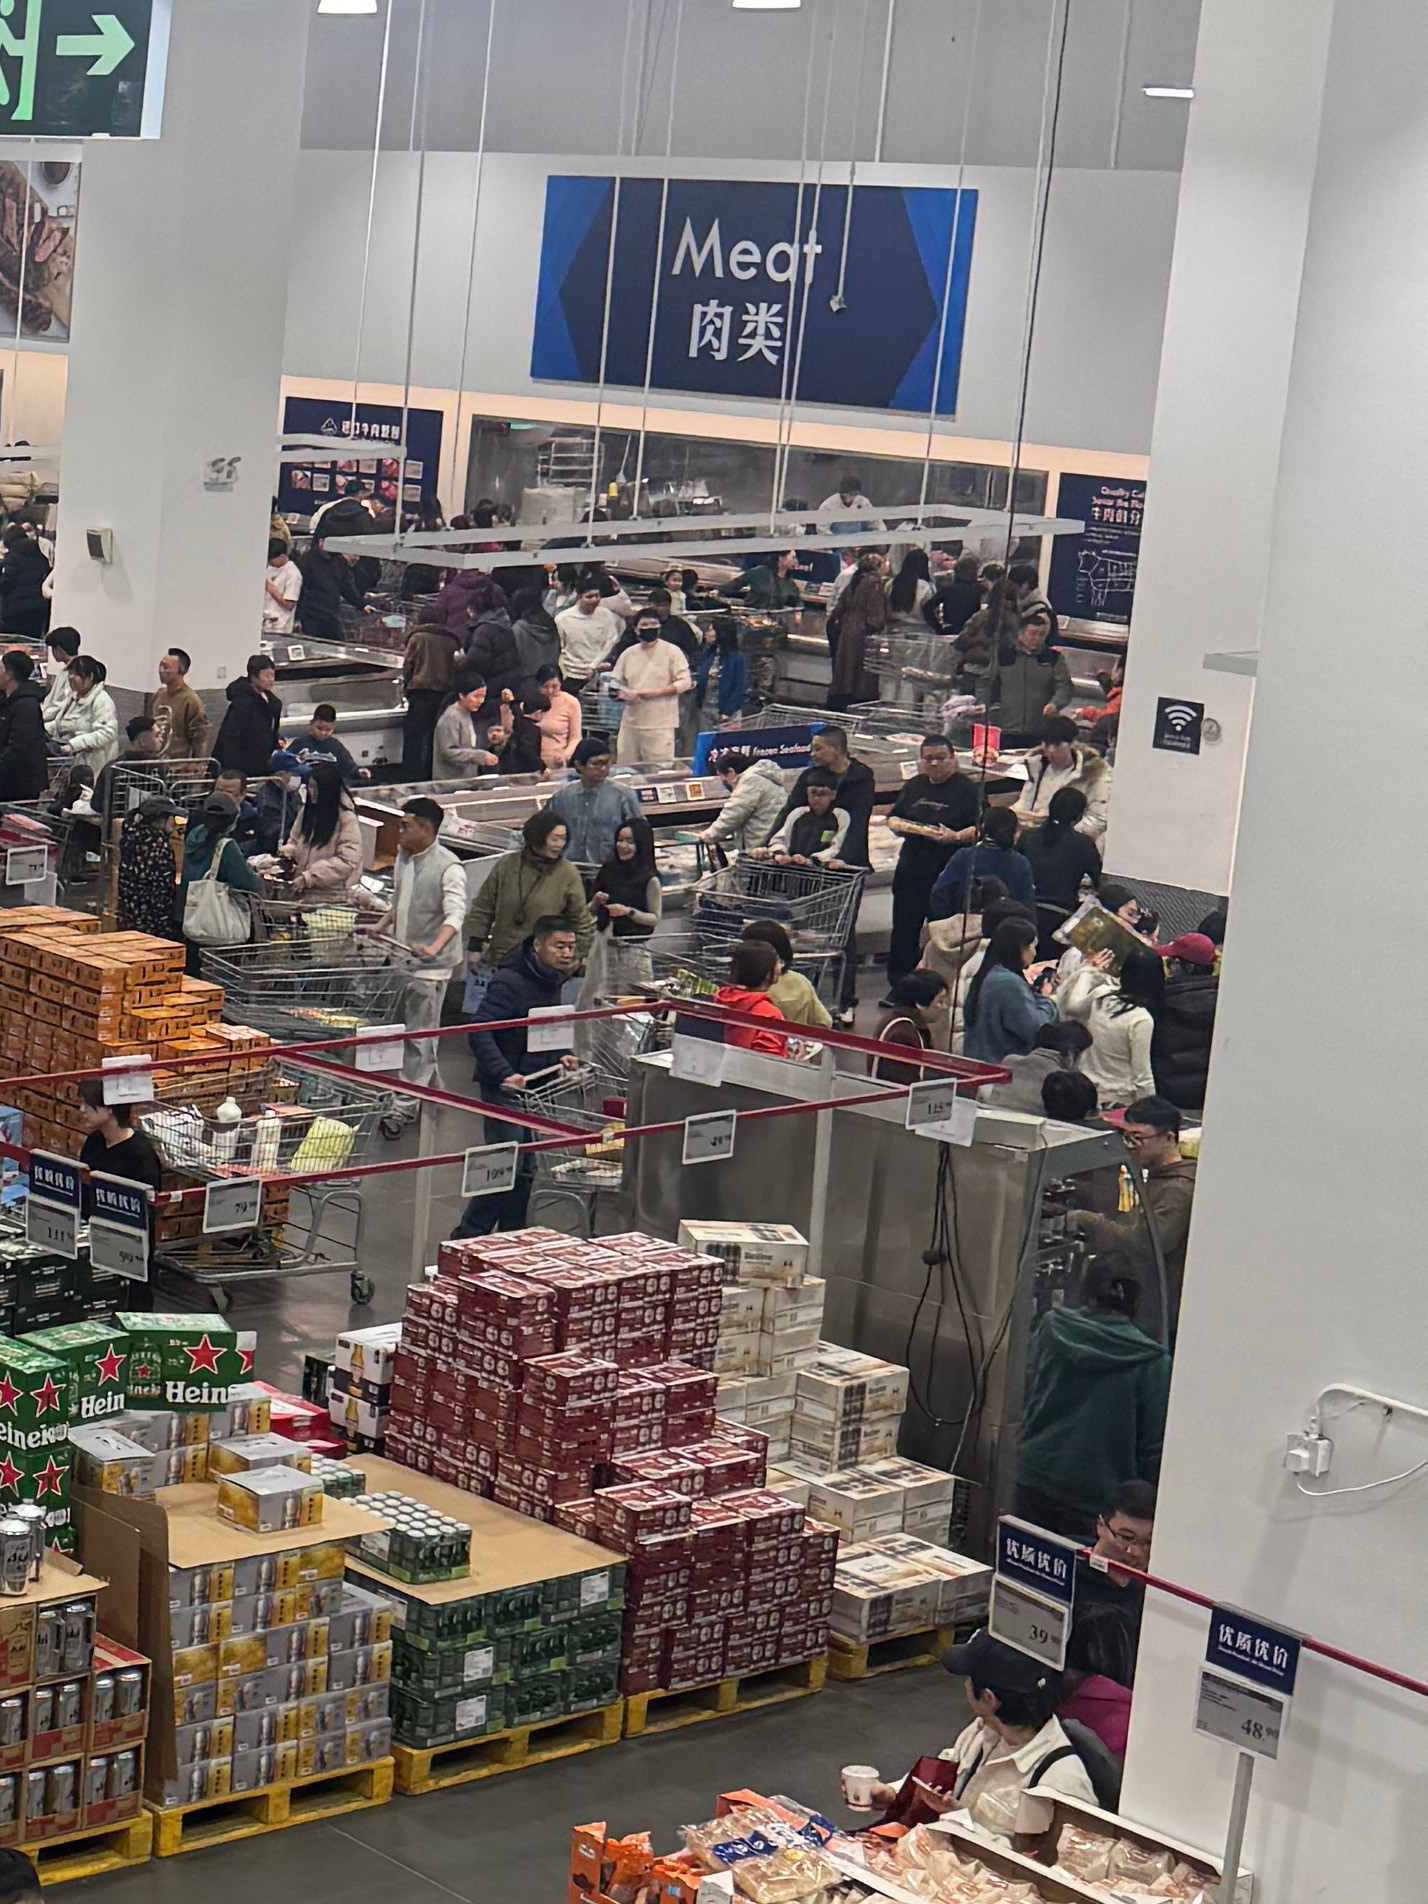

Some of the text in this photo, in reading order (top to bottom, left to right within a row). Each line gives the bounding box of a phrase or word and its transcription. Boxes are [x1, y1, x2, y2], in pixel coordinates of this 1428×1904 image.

[671, 216, 823, 285] Meat
[688, 299, 785, 366] 肉类
[1218, 1622, 1289, 1670] 优质优价
